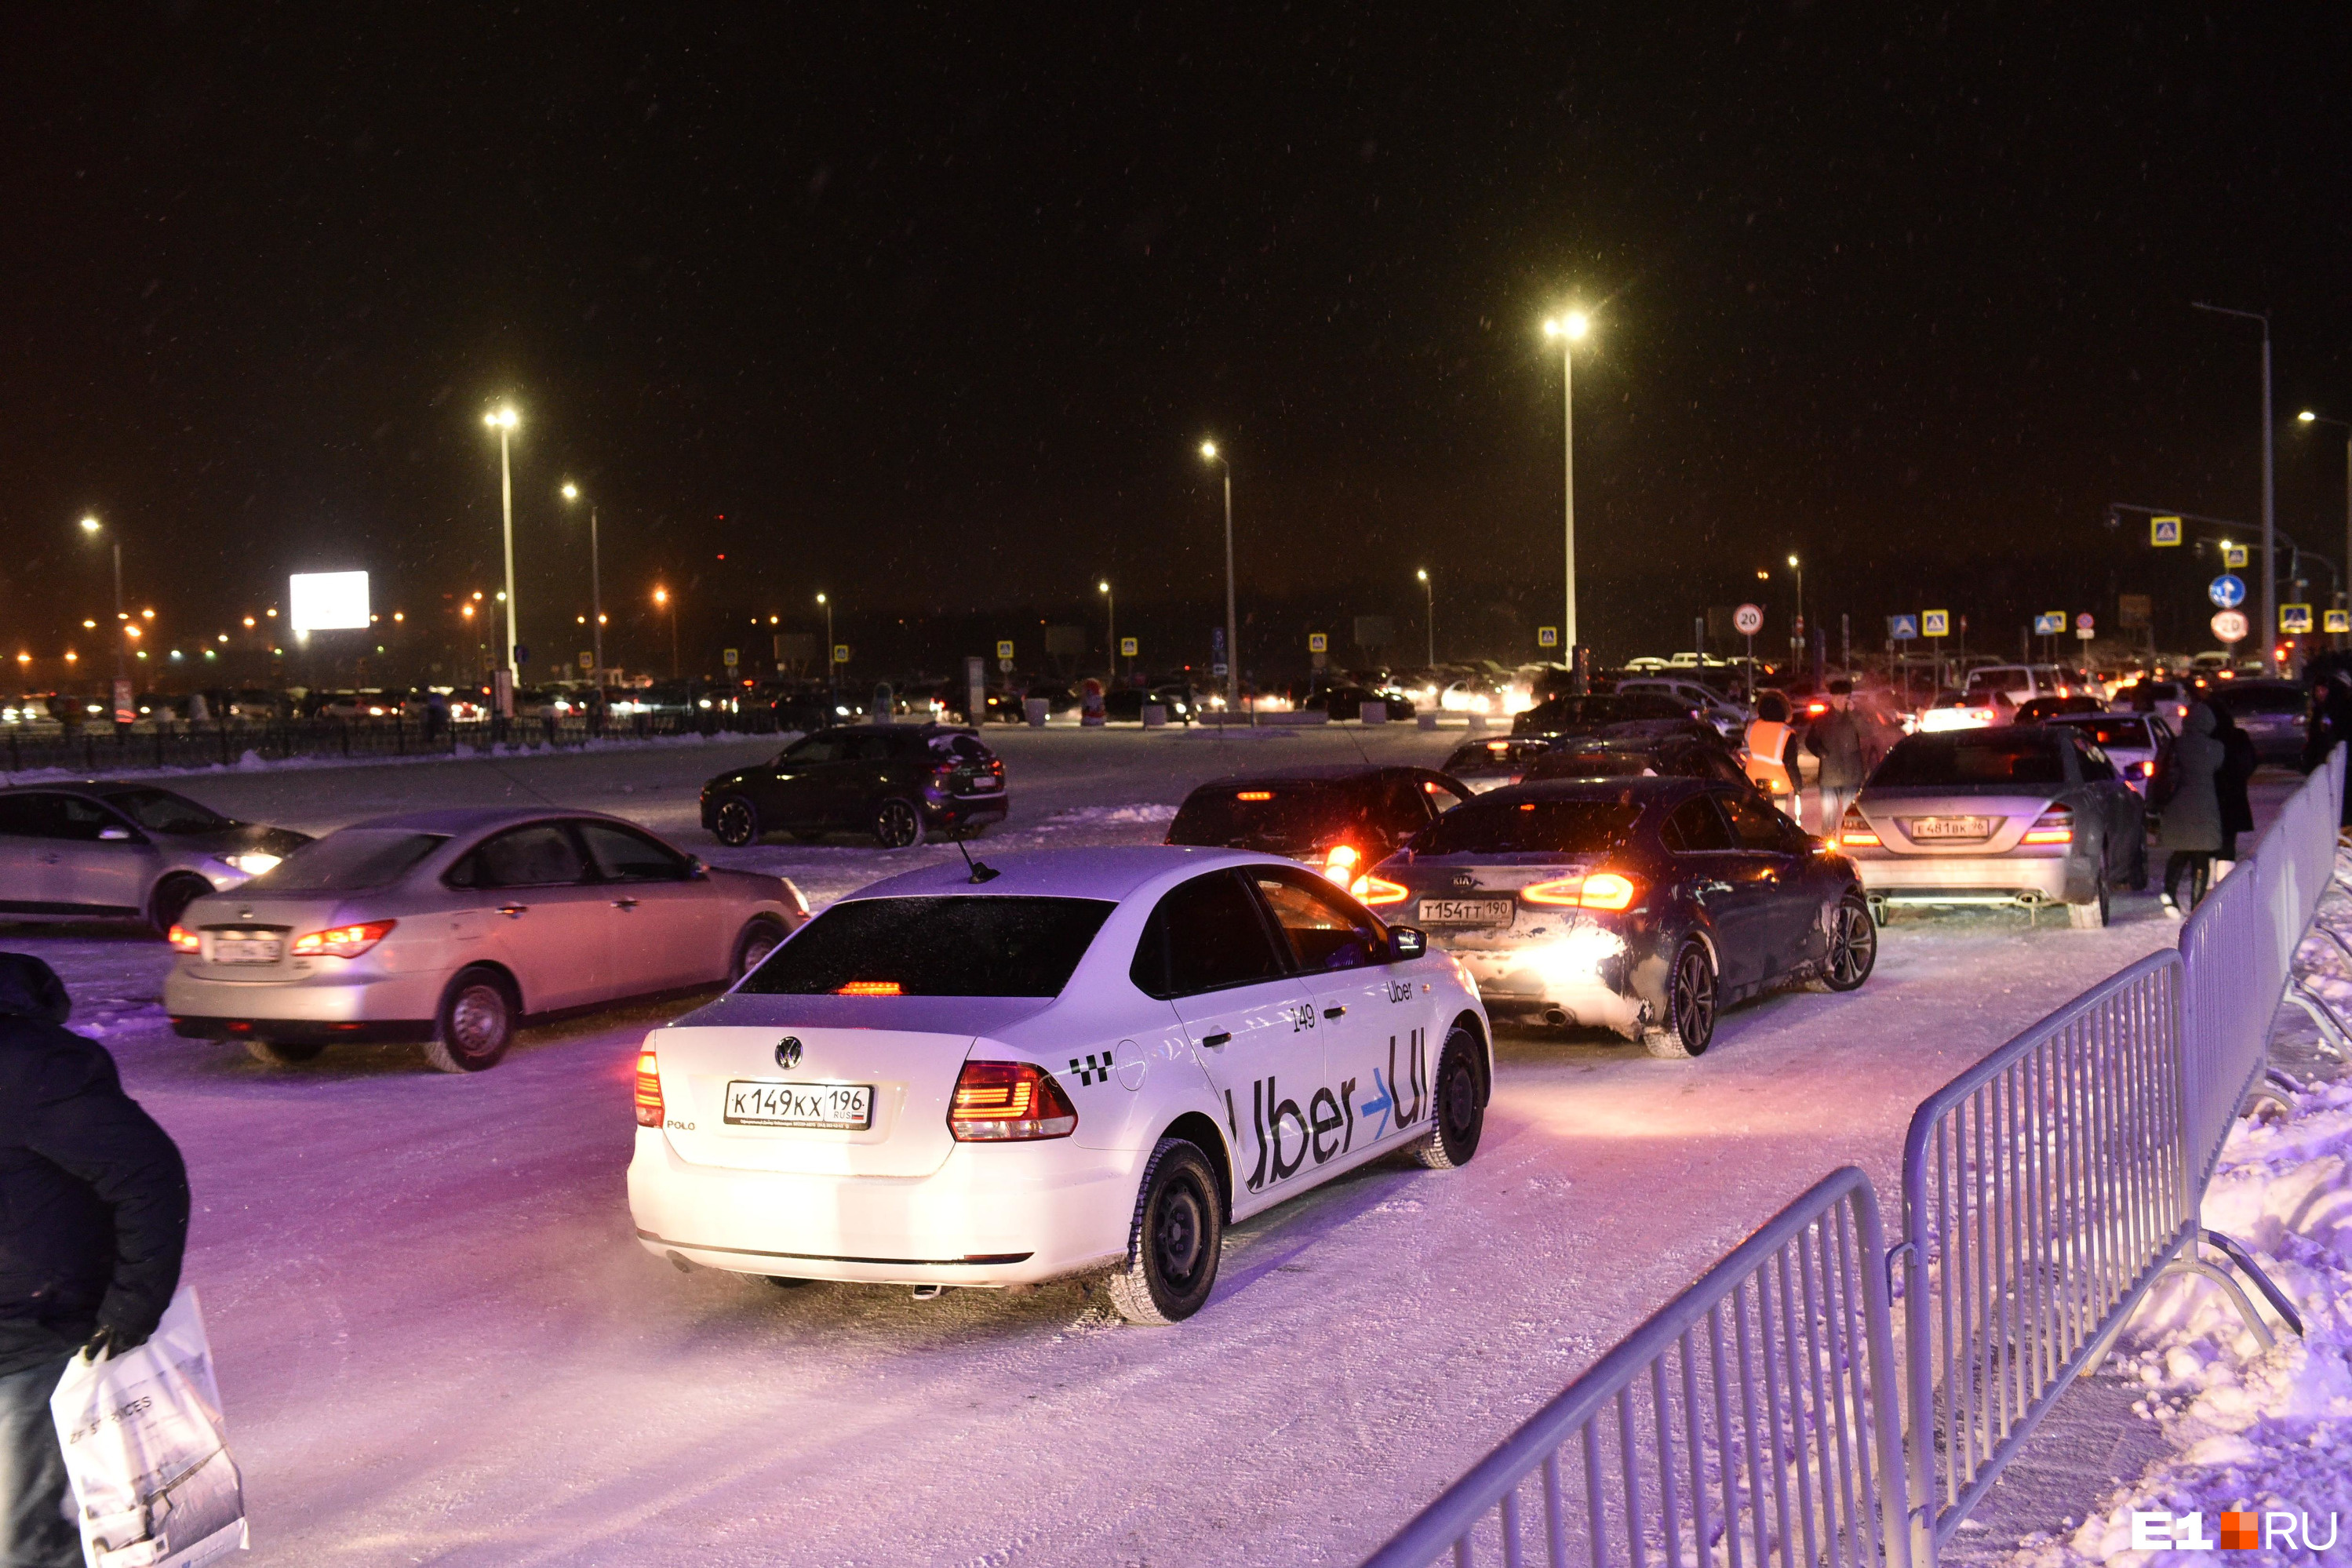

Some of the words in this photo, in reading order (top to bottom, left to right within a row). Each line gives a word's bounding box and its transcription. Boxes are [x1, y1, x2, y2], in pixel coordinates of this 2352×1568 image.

[1741, 613, 1757, 625] 20
[1453, 877, 1470, 886] KIA
[1425, 901, 1482, 919] Т154ТТ
[1486, 901, 1508, 915] 190
[1386, 980, 1412, 1004] Uber
[1290, 1003, 1315, 1033] 149
[734, 1088, 822, 1118] К149КХ
[828, 1090, 861, 1111] 196
[833, 1111, 851, 1119] RUS
[667, 1120, 695, 1130] POLO
[1225, 1075, 1356, 1191] Uber
